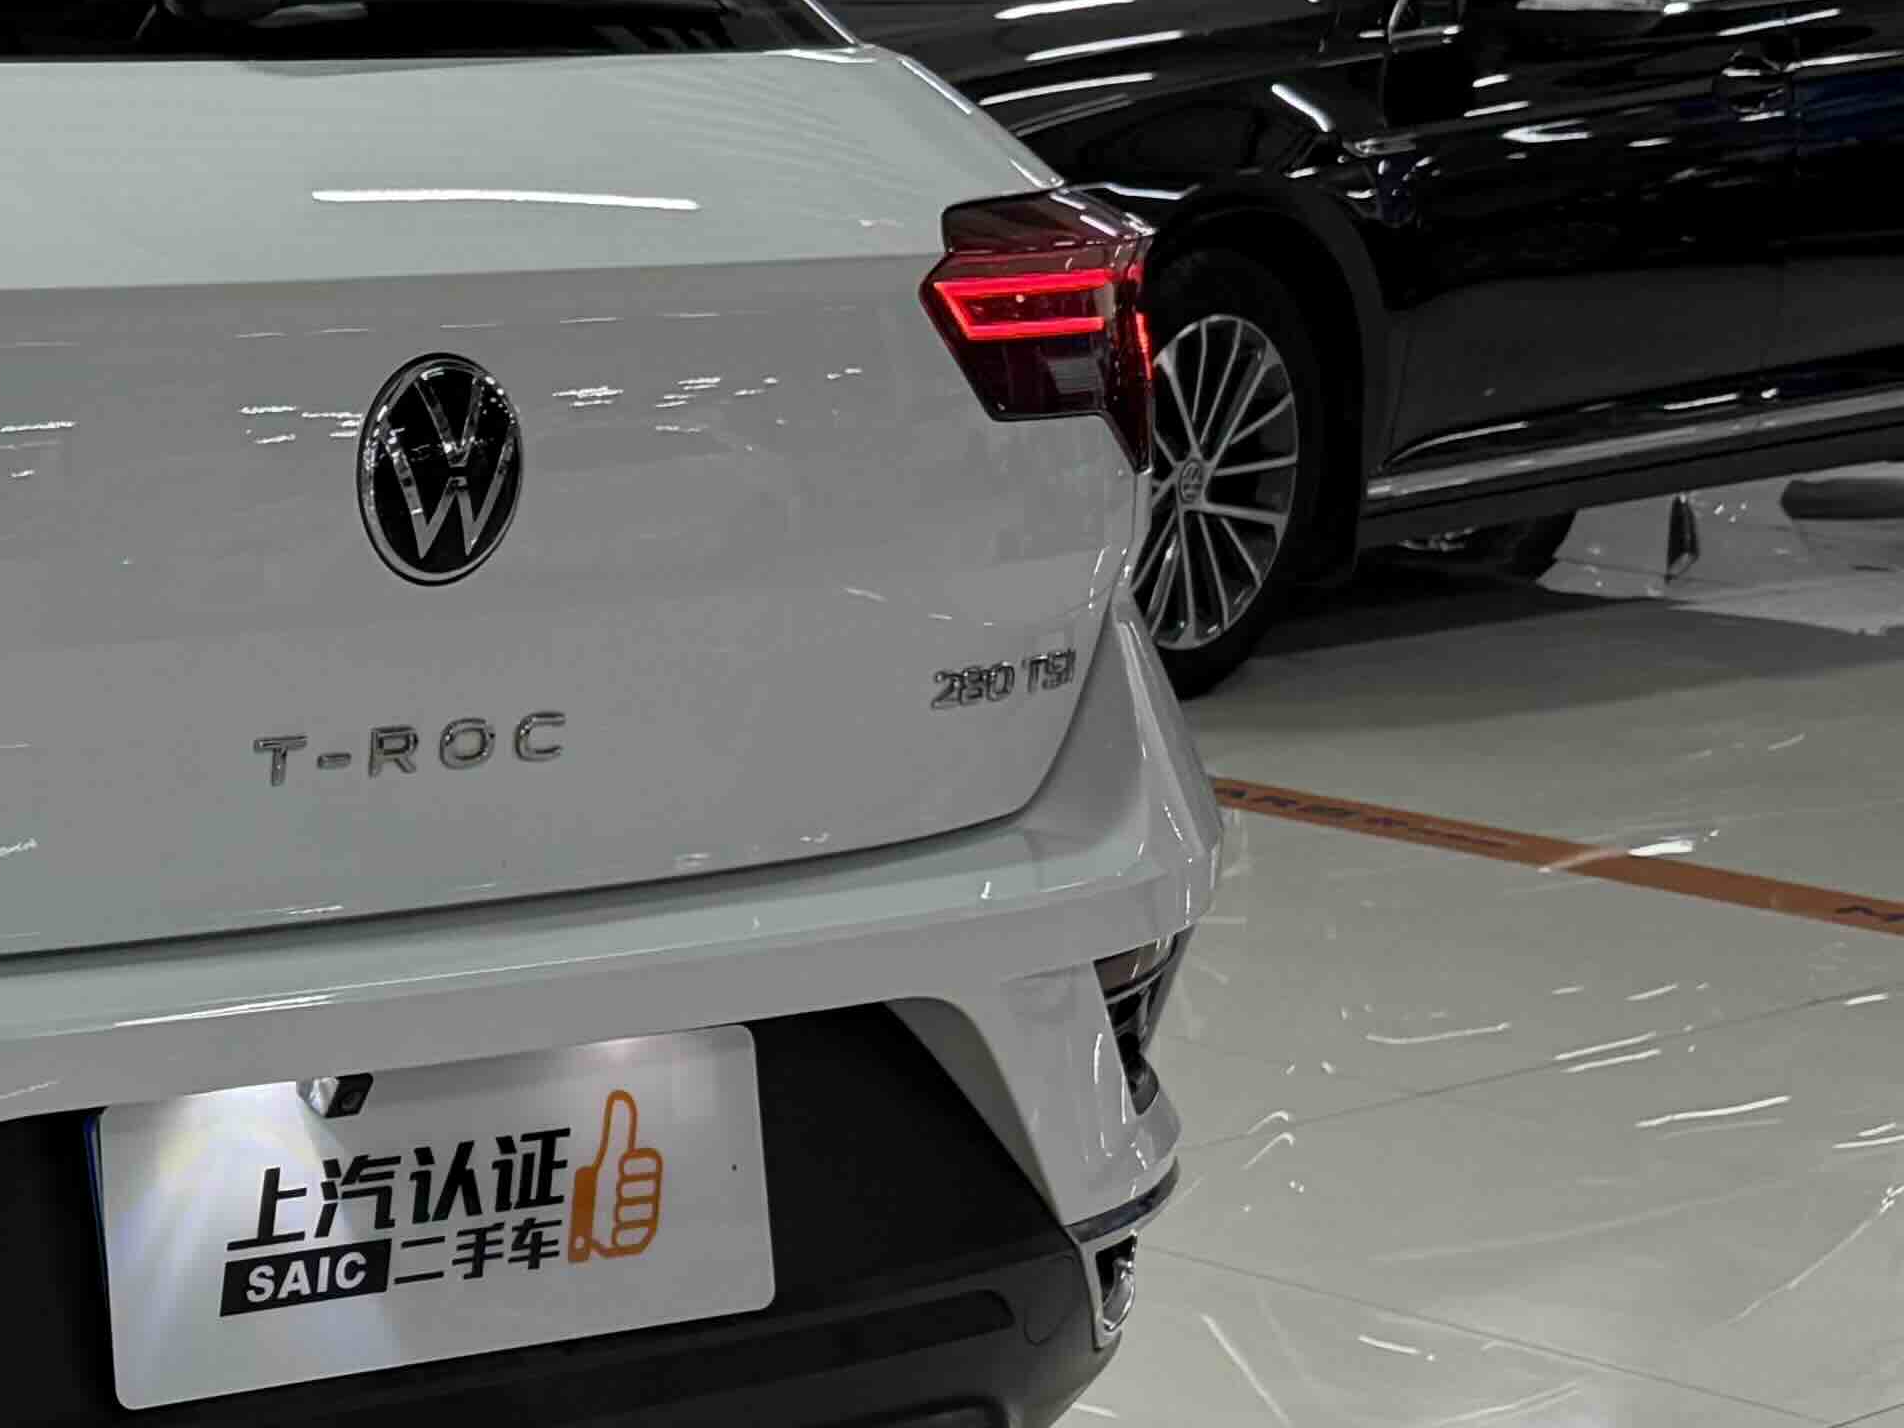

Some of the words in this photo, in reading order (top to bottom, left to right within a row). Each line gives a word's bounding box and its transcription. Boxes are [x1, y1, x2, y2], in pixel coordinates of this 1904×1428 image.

[252, 710, 566, 787] T-ROC
[226, 1127, 571, 1252] 上汽认证
[245, 1251, 368, 1304] SAIC
[394, 1217, 562, 1285] 二手车
